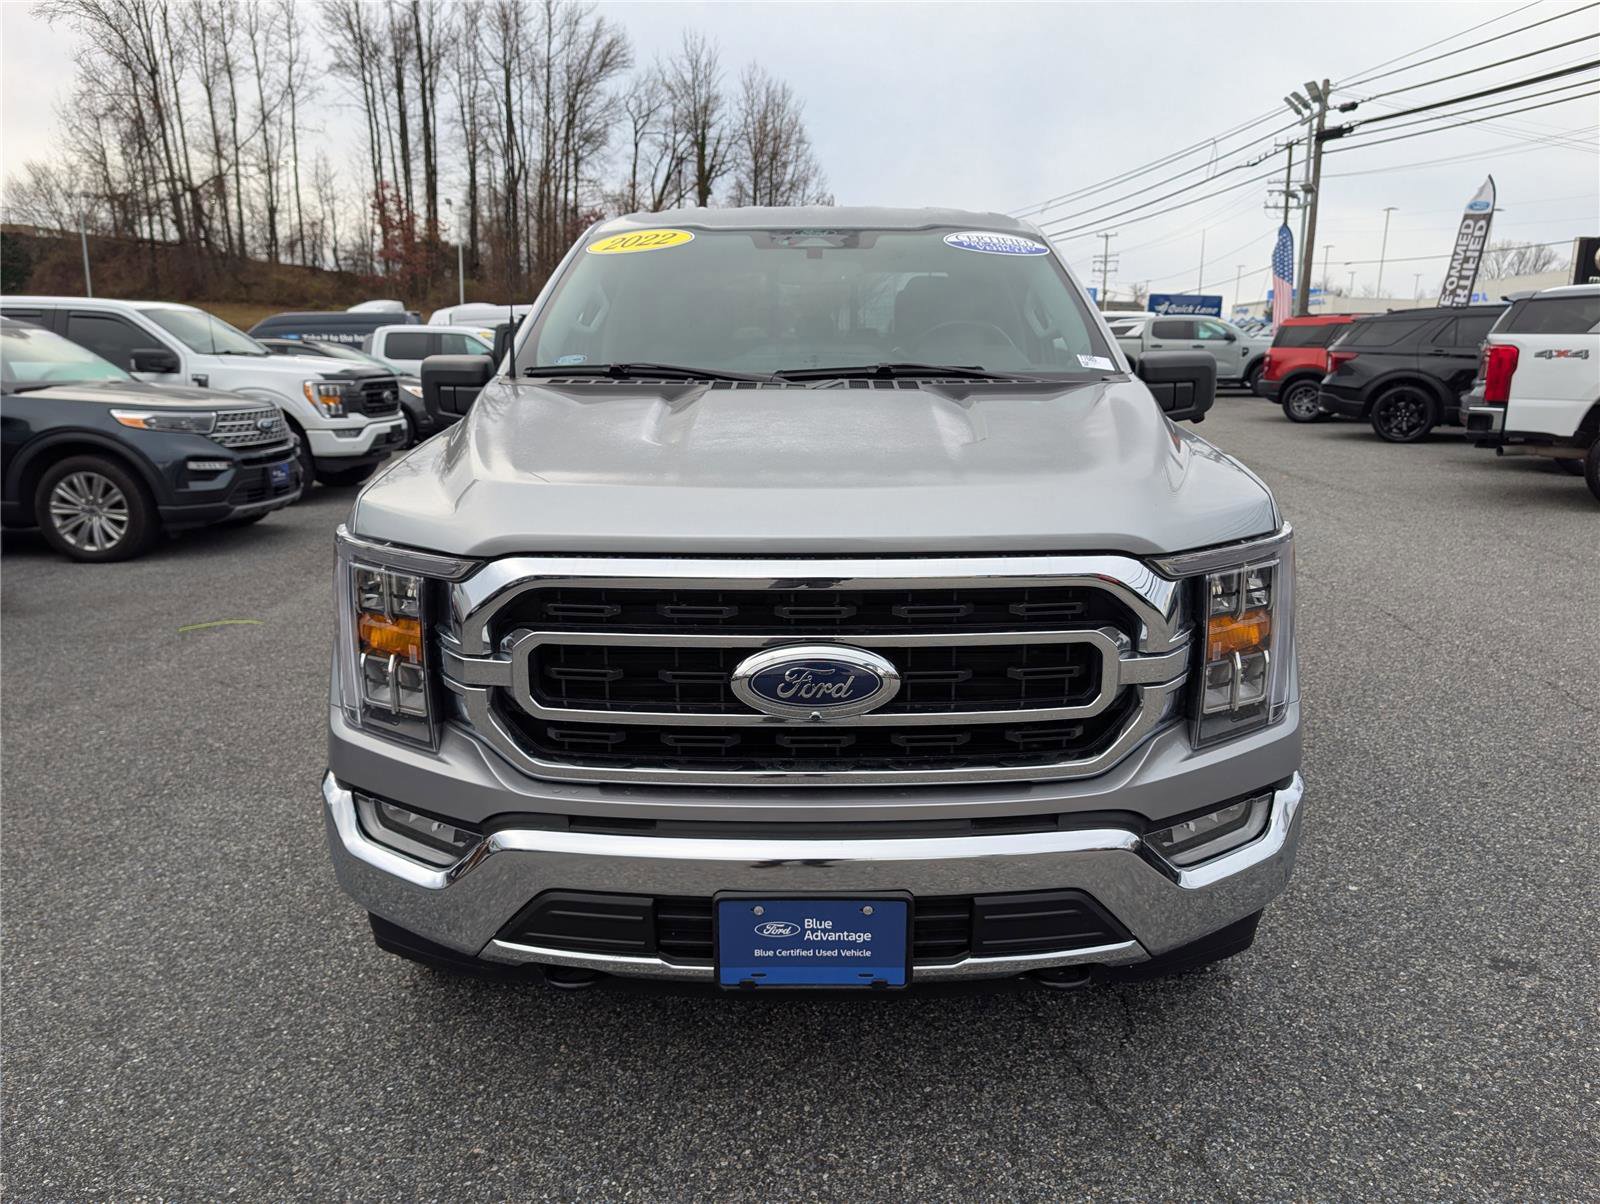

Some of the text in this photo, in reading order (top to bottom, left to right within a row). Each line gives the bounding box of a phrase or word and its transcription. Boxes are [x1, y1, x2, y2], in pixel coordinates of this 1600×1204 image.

[602, 233, 677, 250] 2022
[1168, 304, 1218, 314] Quick Lane
[776, 667, 855, 698] Ford
[763, 923, 792, 935] Ford
[804, 918, 833, 929] Blue
[804, 930, 872, 943] Advantage
[754, 948, 872, 957] Blue Certified Used Vehicle
